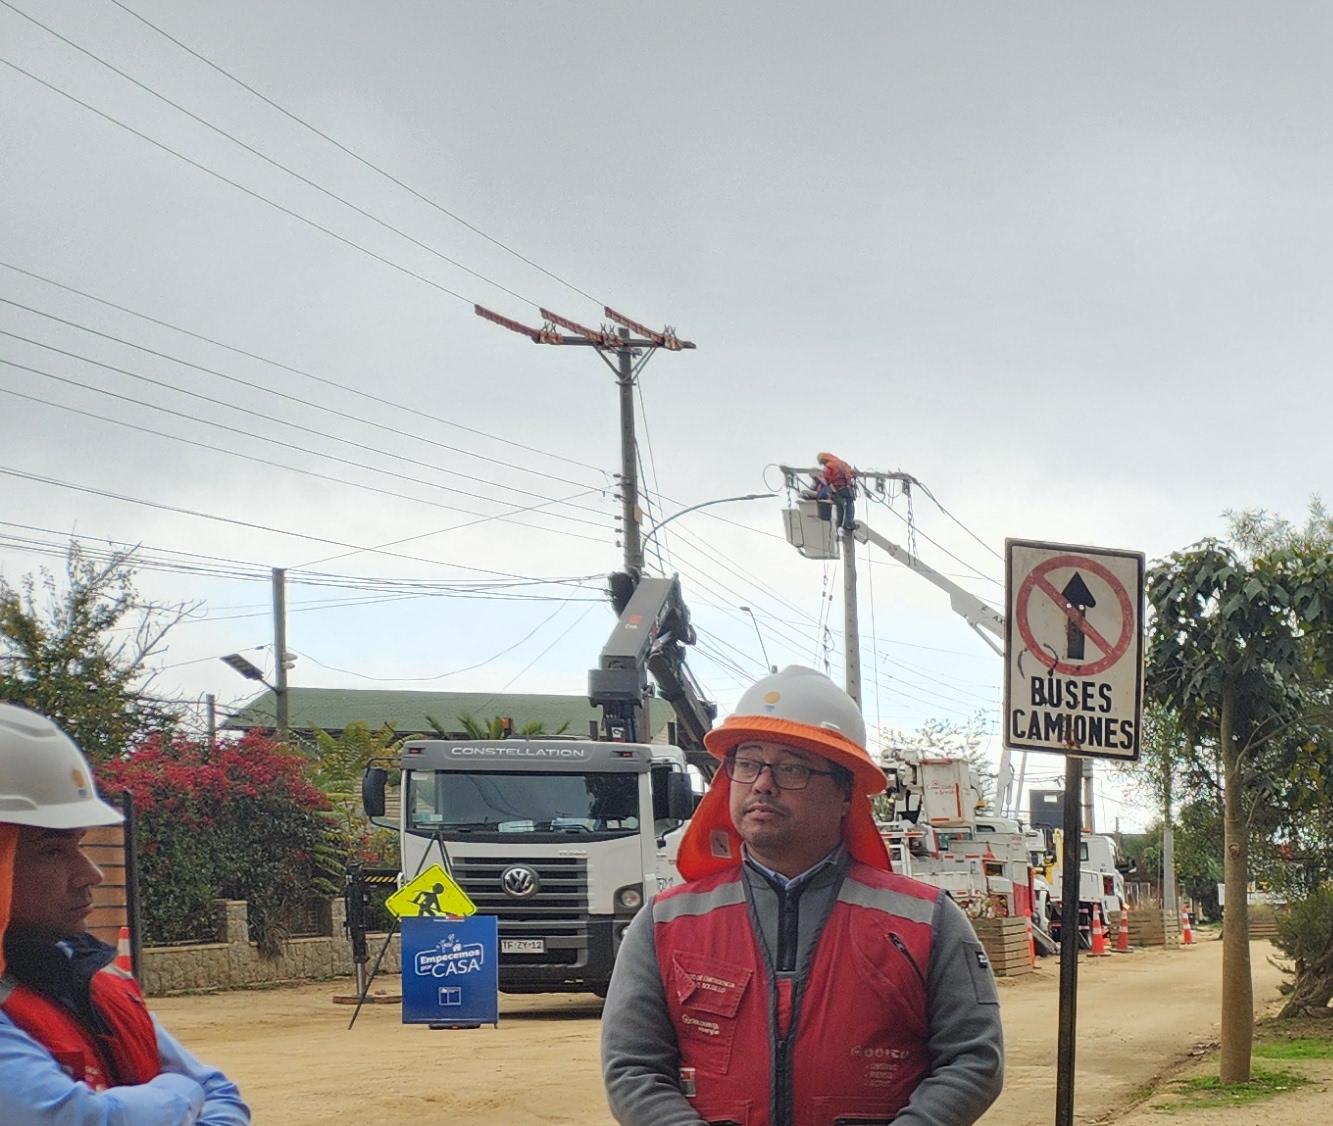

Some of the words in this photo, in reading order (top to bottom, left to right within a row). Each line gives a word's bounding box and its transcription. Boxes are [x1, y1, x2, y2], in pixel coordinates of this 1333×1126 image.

[1031, 676, 1112, 713] BUSES
[1012, 709, 1133, 749] CAMIONES
[451, 746, 585, 757] CONSTELLATION
[420, 949, 480, 965] Empecemos
[431, 958, 480, 978] CASA
